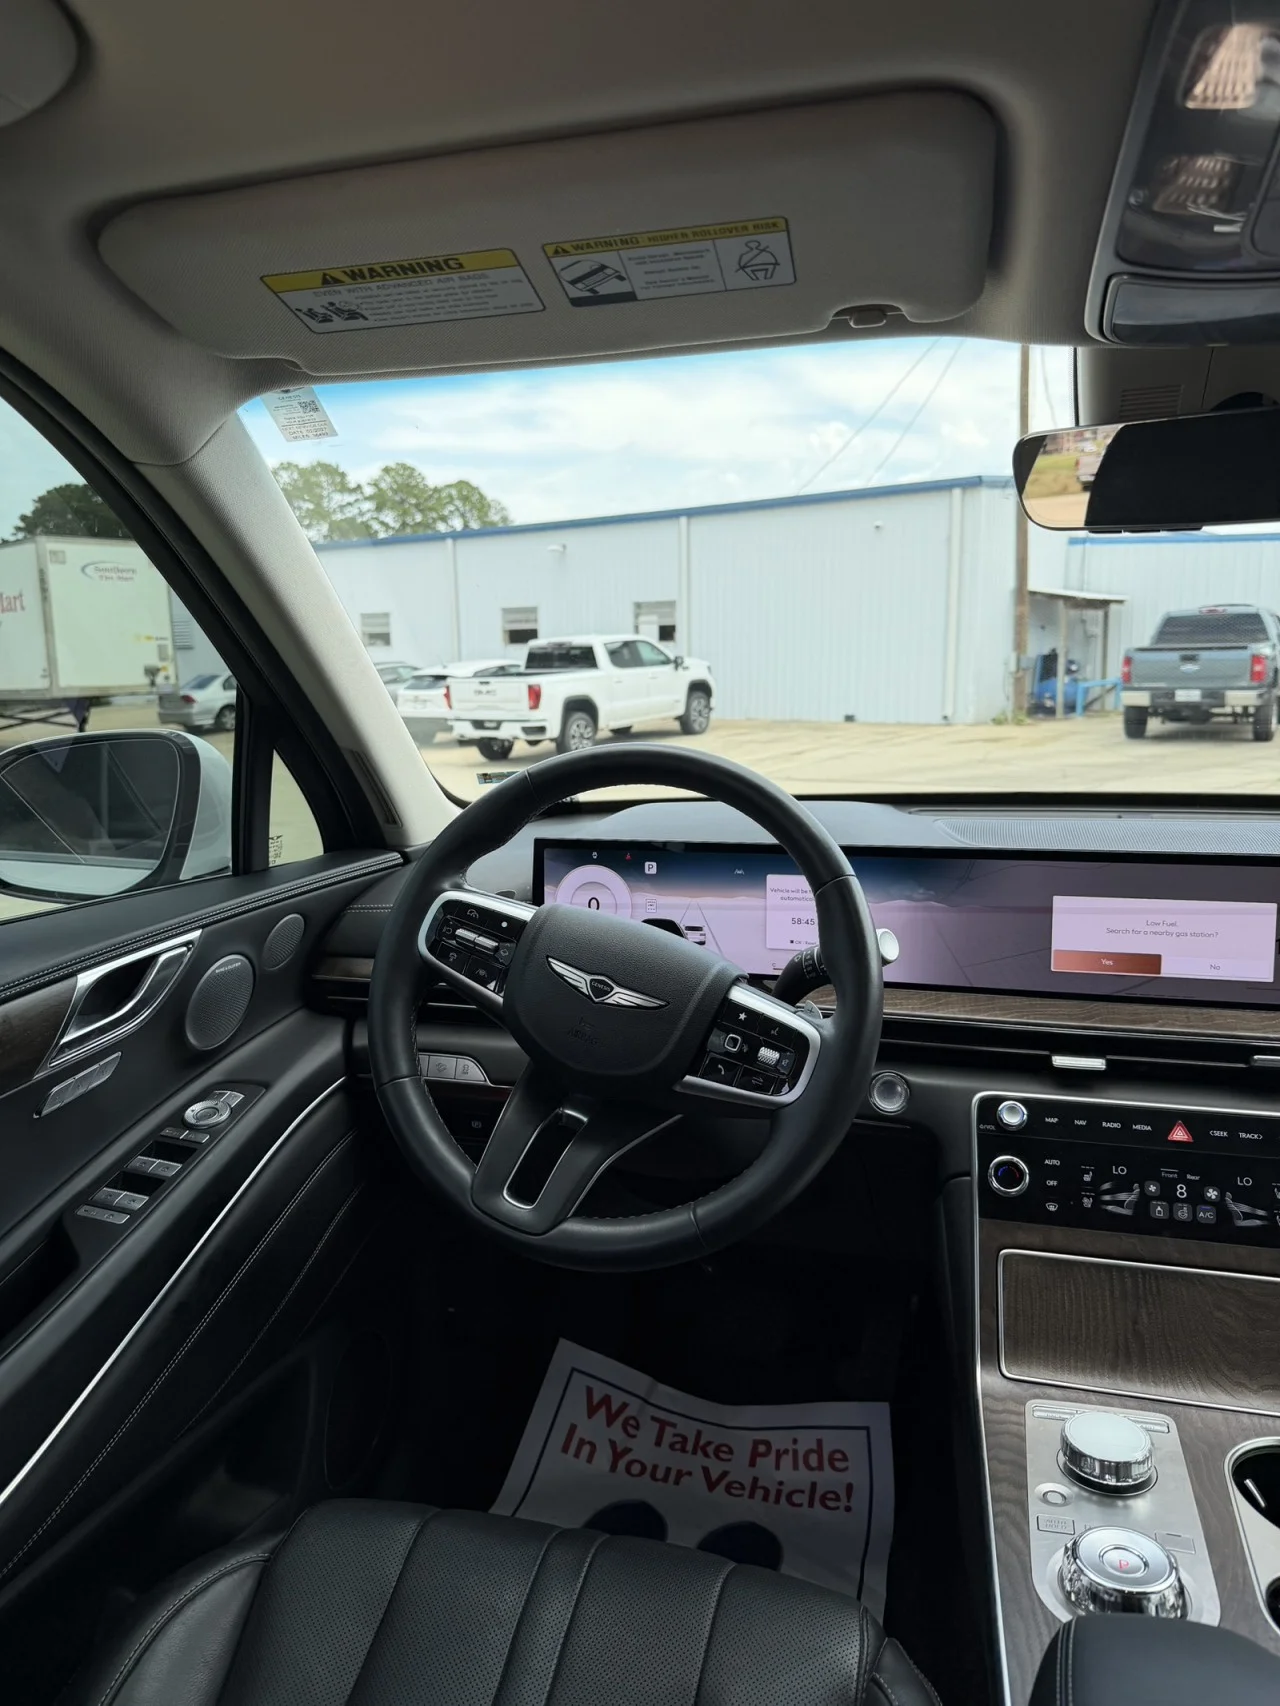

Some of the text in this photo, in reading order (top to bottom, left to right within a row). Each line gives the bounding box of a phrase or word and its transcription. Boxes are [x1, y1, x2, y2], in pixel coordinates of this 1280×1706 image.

[691, 225, 750, 240] ROLLOVER
[752, 220, 780, 232] RISK
[341, 257, 465, 282] WARNING
[0, 590, 26, 614] art
[791, 917, 816, 926] 58:45
[1146, 919, 1160, 927] Low
[1106, 927, 1130, 935] Search
[1149, 929, 1174, 939] nearby
[1101, 958, 1114, 966] Yes
[1102, 1121, 1122, 1129] RADIO
[1132, 1123, 1153, 1132] MEDIA
[1044, 1158, 1061, 1166] AUTO
[1112, 1165, 1128, 1175] LO
[1046, 1179, 1058, 1187] OFF
[1237, 1176, 1253, 1186] LO
[1176, 1183, 1187, 1199] 8
[1198, 1211, 1215, 1219] A/C
[585, 1386, 850, 1472] We Take Pride
[561, 1422, 855, 1513] In Your Vehicle!
